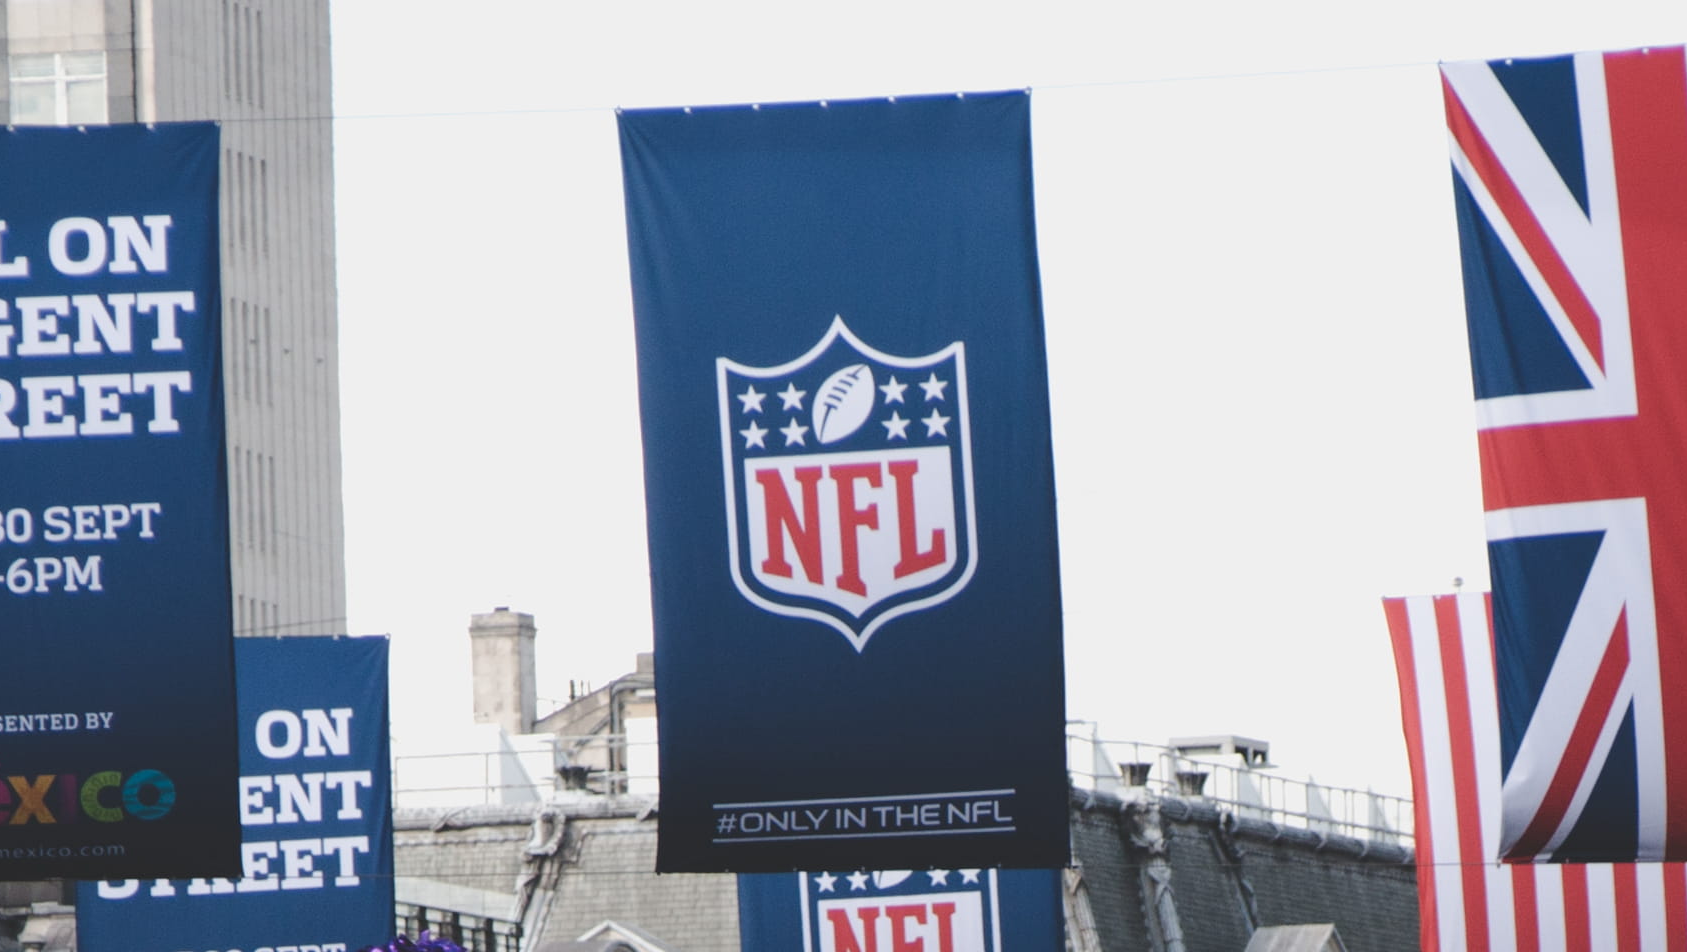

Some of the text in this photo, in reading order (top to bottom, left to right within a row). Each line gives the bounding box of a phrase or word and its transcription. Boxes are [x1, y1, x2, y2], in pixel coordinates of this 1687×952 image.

[47, 214, 173, 276] ON
[43, 502, 162, 542] SEPT
[754, 459, 947, 598] NFL
[85, 711, 114, 730] BY
[254, 707, 354, 759] ON
[238, 770, 372, 826] ENT
[716, 800, 1013, 834] #ONLY IN THE NFL
